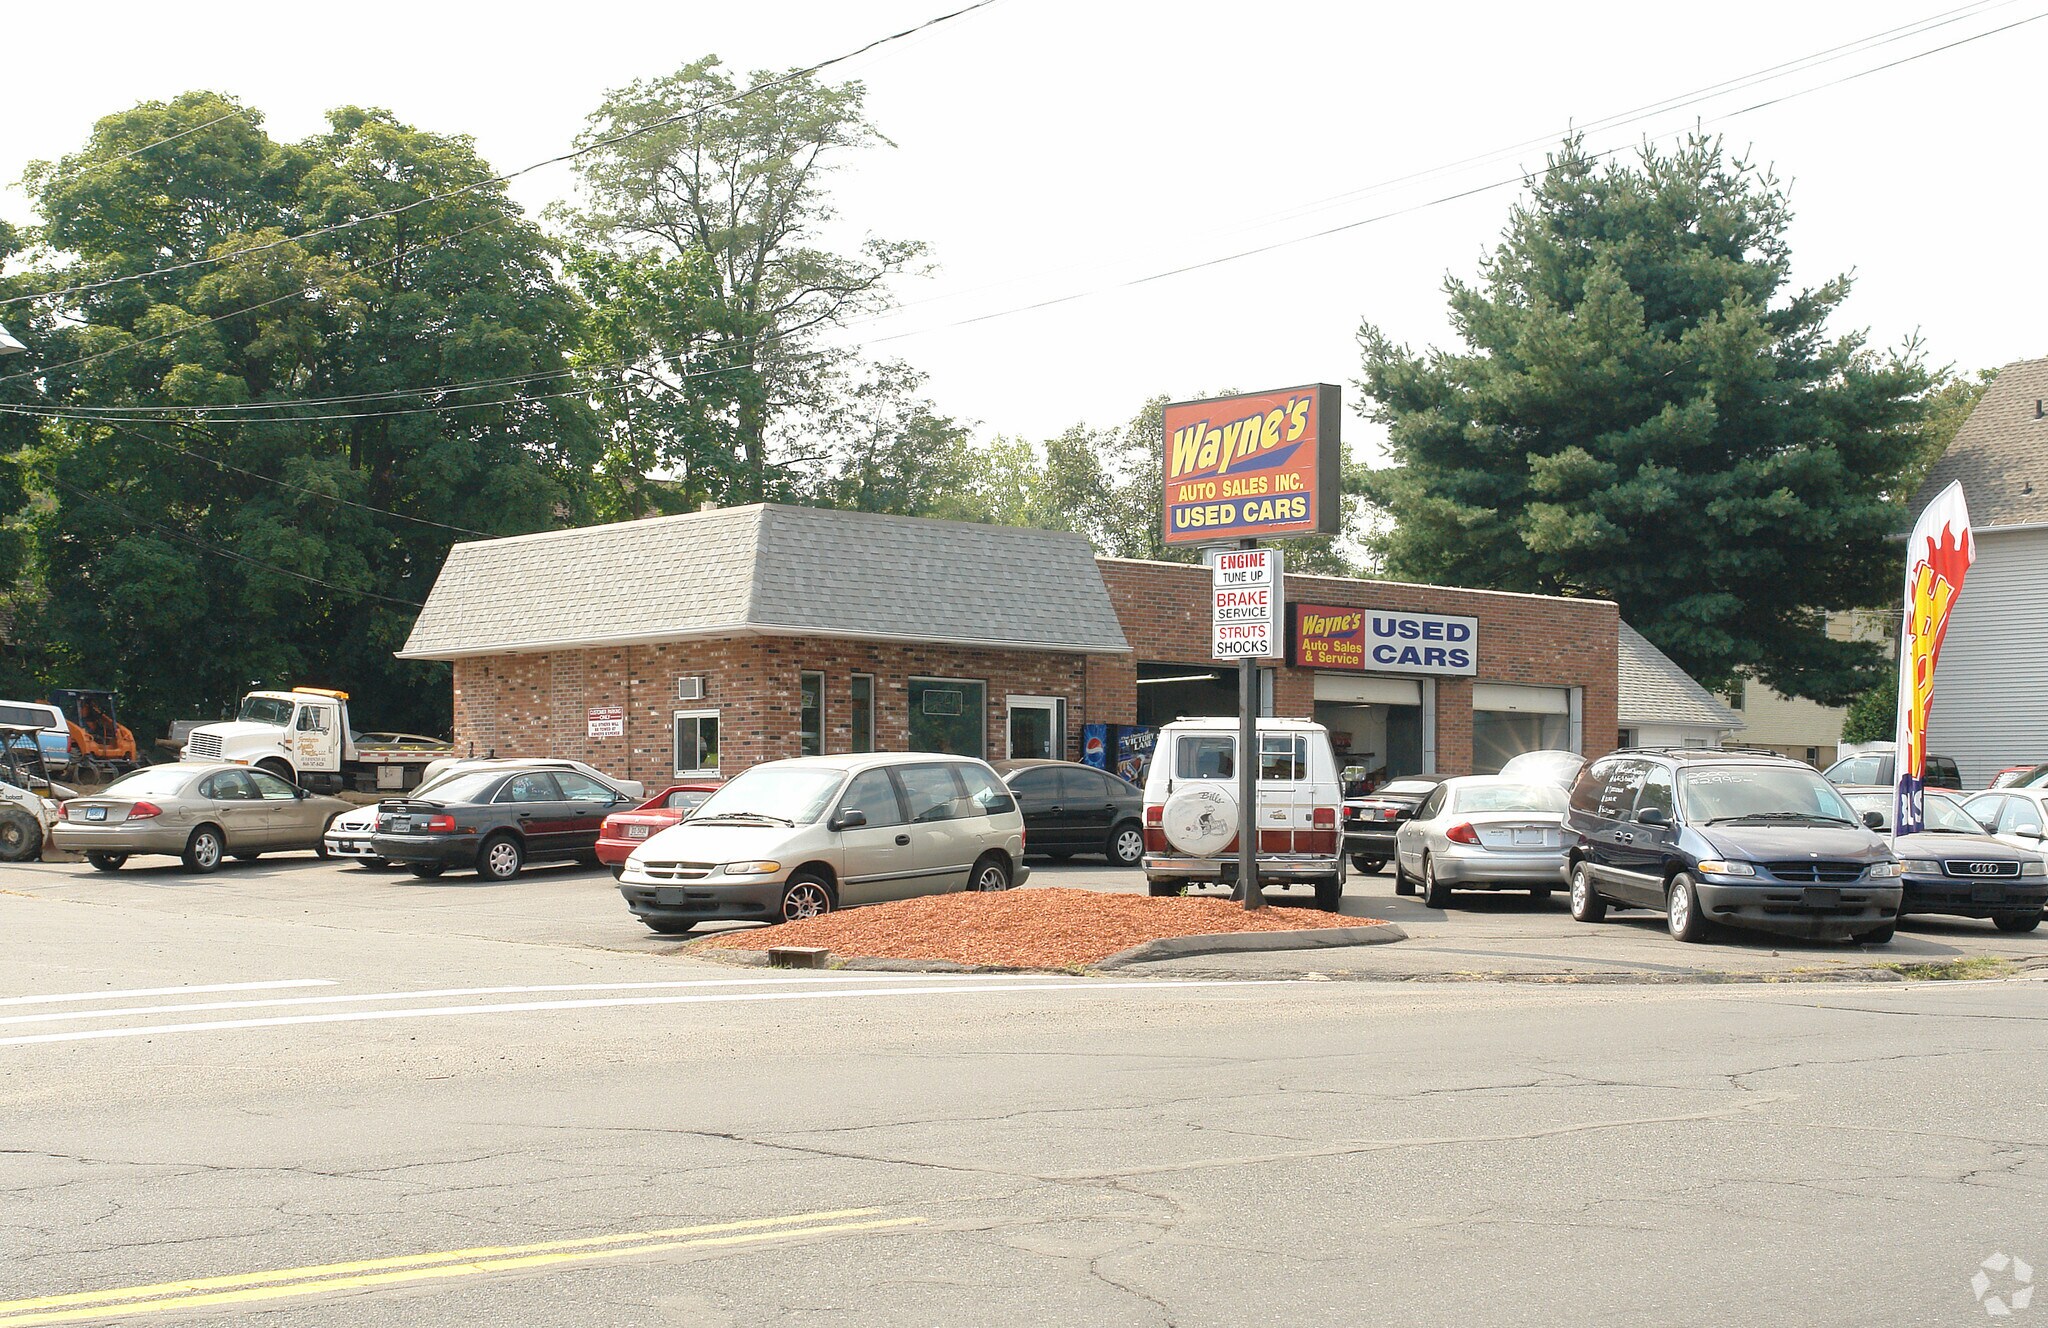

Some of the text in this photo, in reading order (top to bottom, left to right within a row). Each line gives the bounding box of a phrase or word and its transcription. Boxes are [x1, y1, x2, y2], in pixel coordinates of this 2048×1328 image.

[1170, 397, 1311, 478] Wayne's
[1178, 473, 1304, 502] AUTO SALES INC.
[1176, 497, 1306, 528] USED CARS
[1220, 553, 1265, 569] ENGINE
[1223, 571, 1263, 583] TUNE UP
[1217, 591, 1268, 607] BRAKE
[1218, 607, 1267, 619] SERVICE
[1219, 625, 1266, 639] STRUTS
[1302, 612, 1362, 638] Wayne's
[1372, 617, 1471, 642] USED
[1217, 640, 1268, 654] SHOCKS
[1302, 638, 1362, 654] Auto Sales
[1305, 650, 1359, 665] & Service
[1372, 645, 1470, 668] CARS
[1124, 733, 1155, 746] VICTORY
[1134, 740, 1153, 751] LANE
[1199, 792, 1225, 804] Bills
